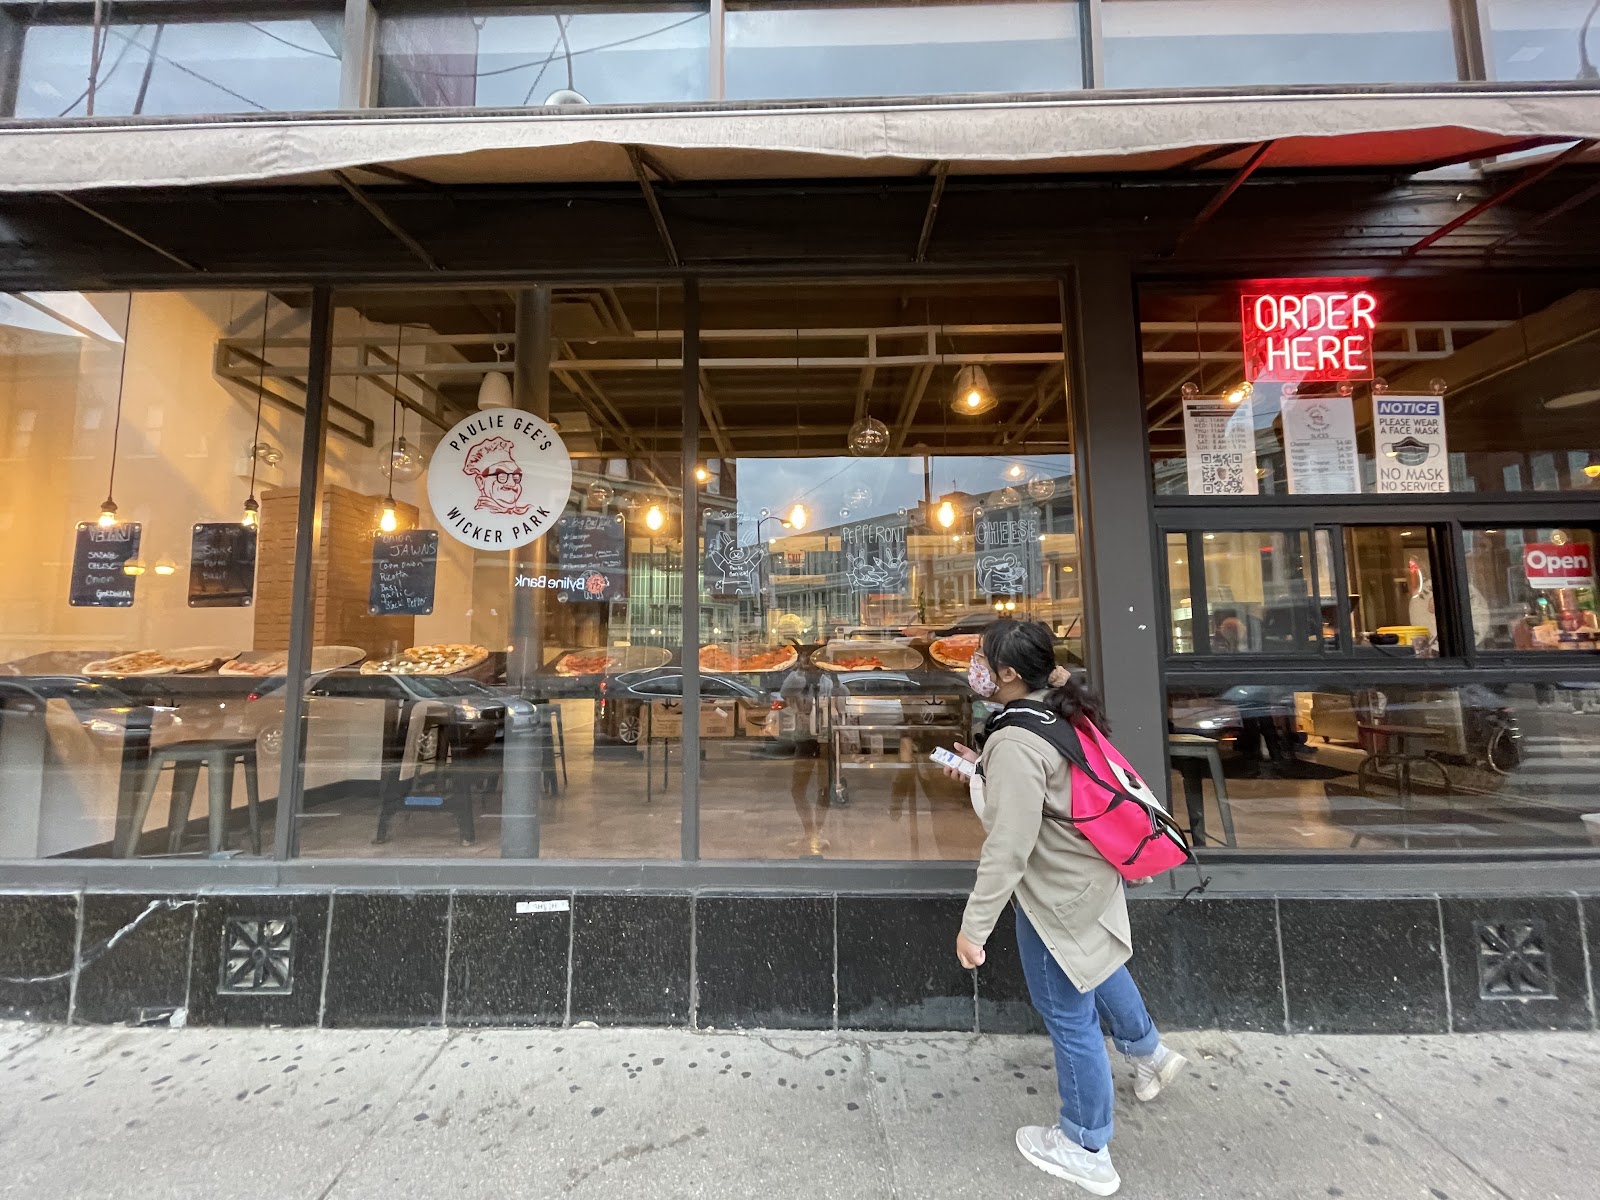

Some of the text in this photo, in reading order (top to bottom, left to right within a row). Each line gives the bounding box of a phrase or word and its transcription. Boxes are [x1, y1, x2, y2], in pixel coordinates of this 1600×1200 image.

[1254, 293, 1377, 332] ORDER
[1266, 335, 1368, 371] HERE
[1380, 402, 1437, 414] NOTICE
[1379, 418, 1439, 427] PLEASE WEAR
[1414, 427, 1439, 435] MASK
[450, 415, 552, 451] PAULIE GEE'S
[1380, 468, 1444, 481] NO MASK
[1381, 482, 1445, 492] NO SERVICE
[88, 524, 132, 543] VEGAN
[447, 505, 551, 543] WICKER PARK
[975, 519, 1038, 545] CHEESE
[842, 524, 907, 545] PEPPERONI
[390, 543, 437, 557] JAWNS
[1526, 550, 1589, 574] Open
[379, 570, 409, 581] Ricotta
